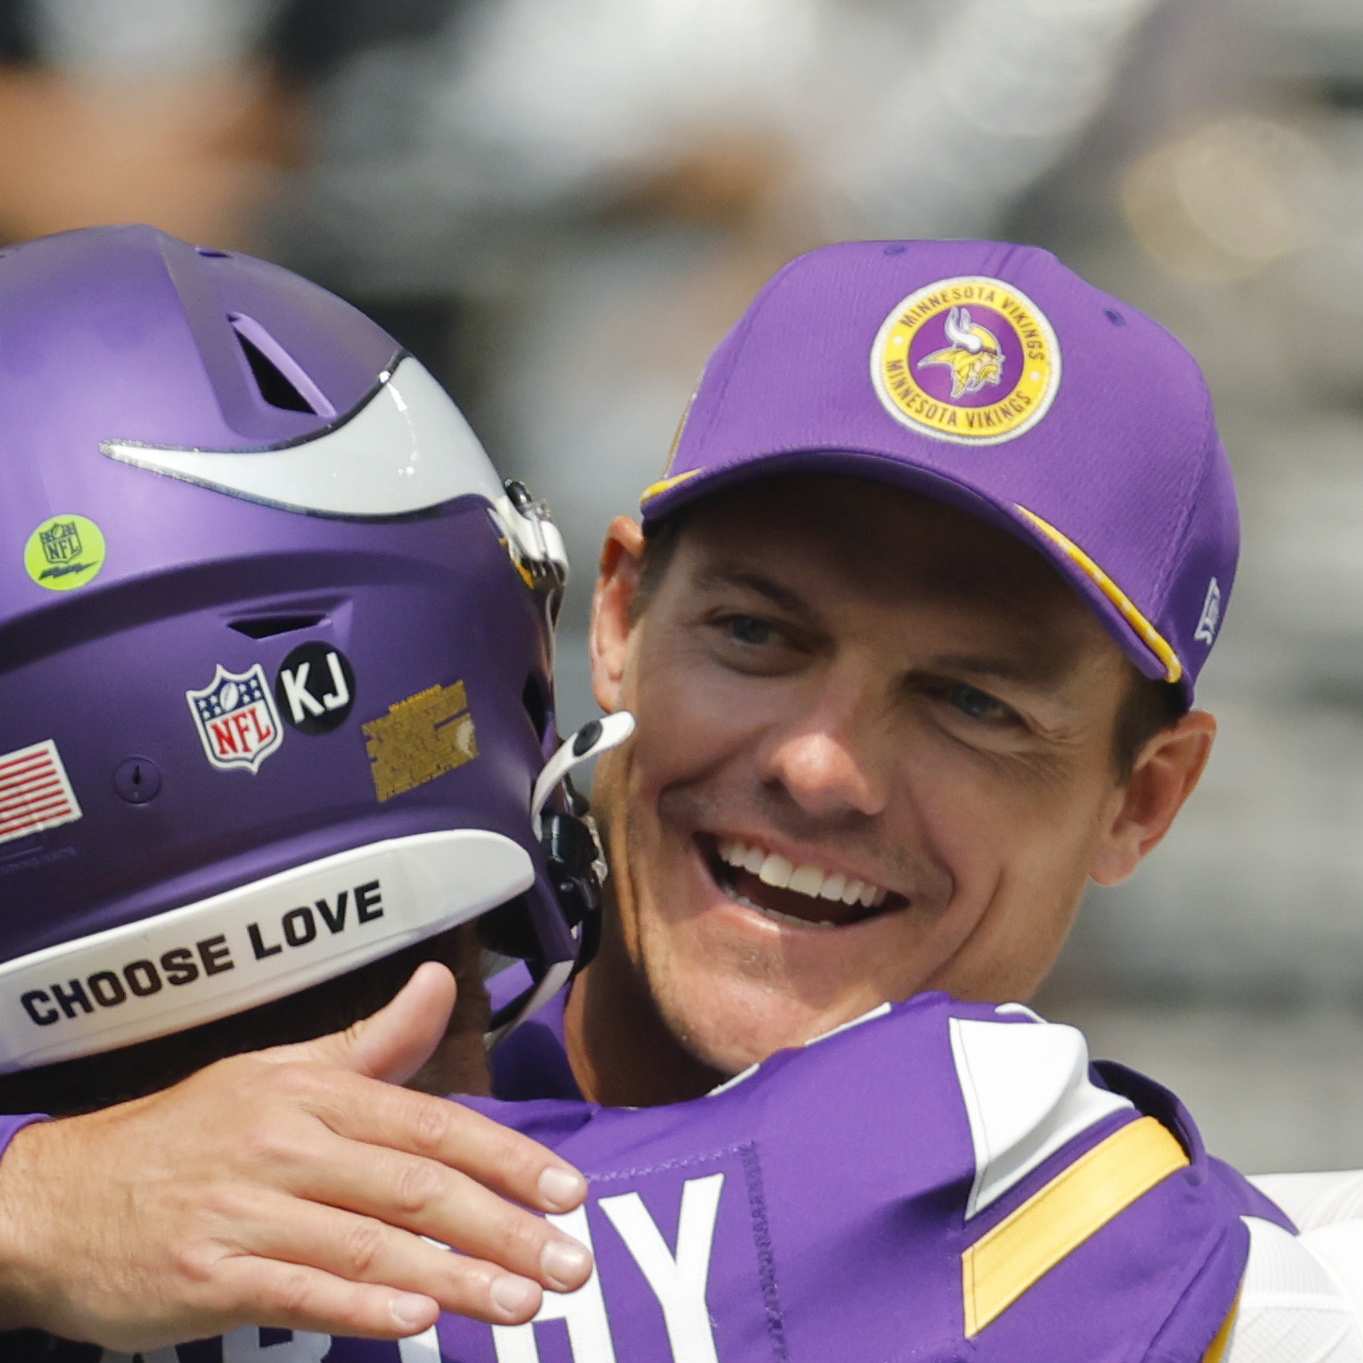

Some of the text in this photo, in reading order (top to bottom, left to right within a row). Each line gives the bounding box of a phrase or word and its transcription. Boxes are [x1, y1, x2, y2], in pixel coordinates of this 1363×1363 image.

[900, 285, 1046, 361] MINNESOTA VIKINGS
[886, 358, 1033, 429] MINNESOTA VIKINGS
[45, 536, 79, 561] NFL
[280, 651, 350, 725] KJ
[210, 706, 272, 756] NFL
[20, 879, 385, 1026] CHOOSE LOVE
